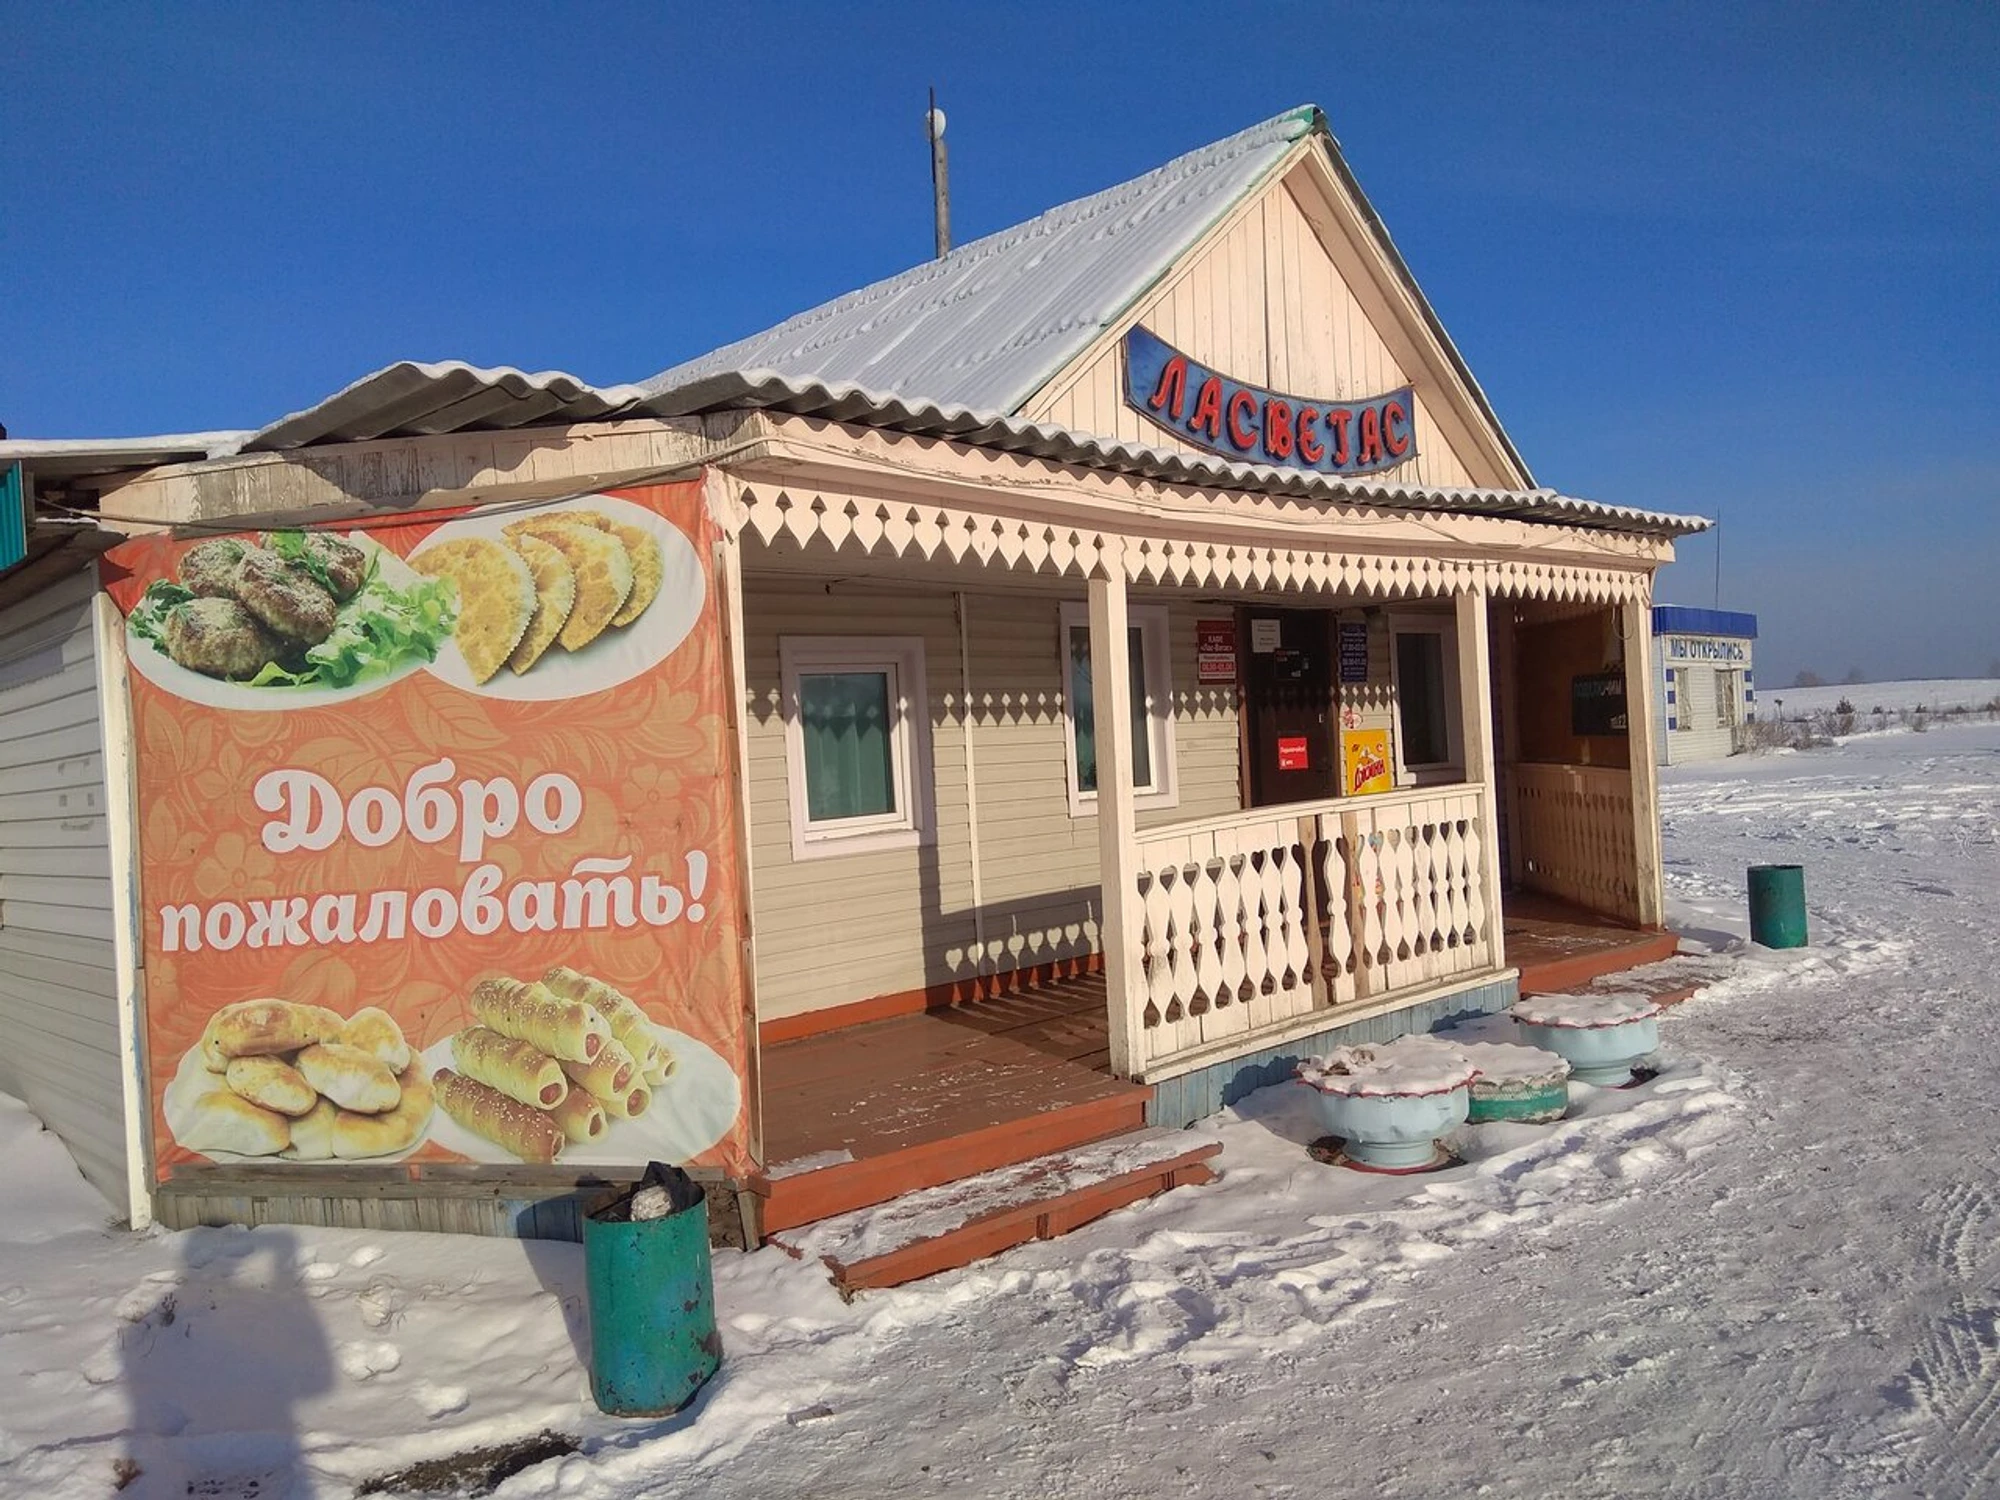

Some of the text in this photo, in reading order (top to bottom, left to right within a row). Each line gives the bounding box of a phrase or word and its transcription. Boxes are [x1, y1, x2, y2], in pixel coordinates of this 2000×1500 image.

[1671, 639, 1743, 660] МЫ ОТКРЫЛИСЬ
[254, 758, 582, 863] Добро
[160, 850, 709, 952] пожаловать!
